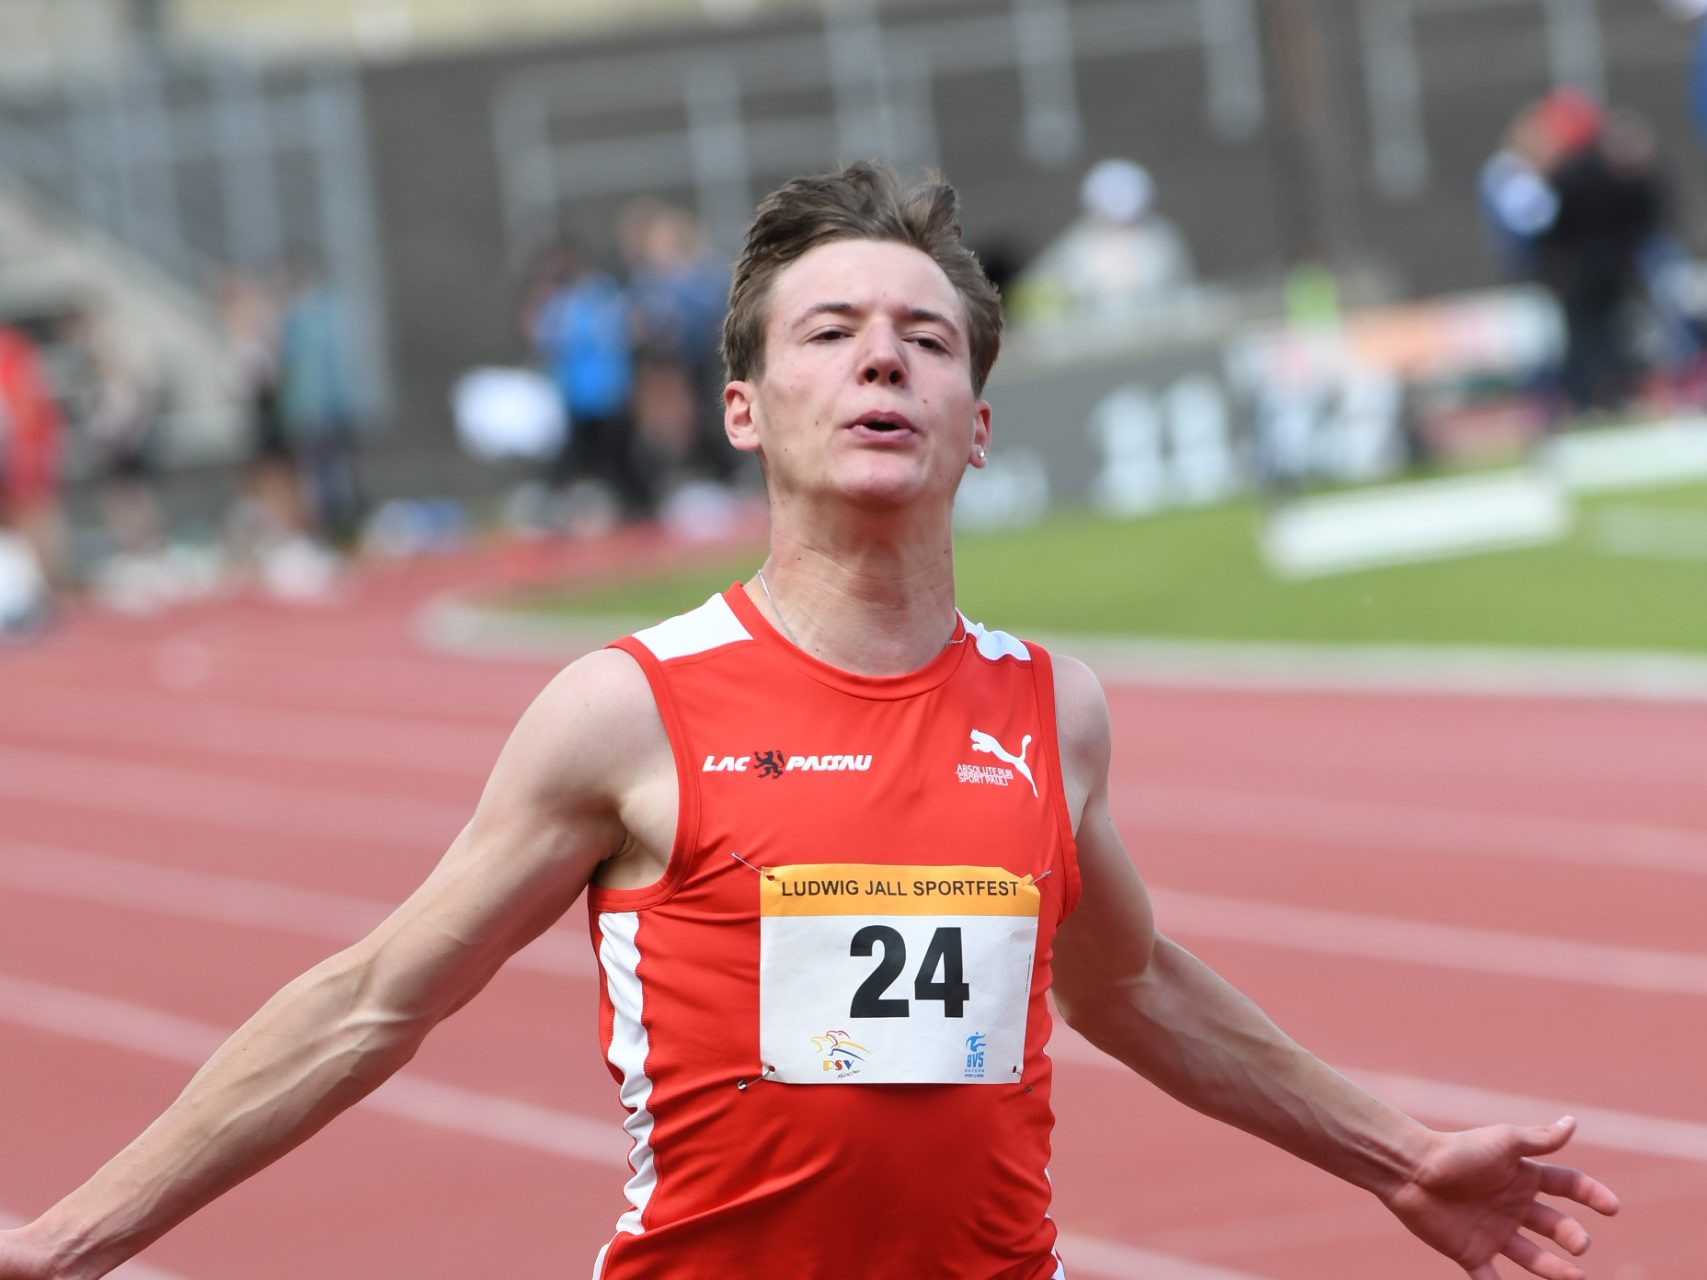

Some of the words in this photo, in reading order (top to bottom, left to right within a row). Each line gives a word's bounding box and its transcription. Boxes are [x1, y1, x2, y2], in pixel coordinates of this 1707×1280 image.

[702, 755, 750, 772] LAC
[786, 754, 872, 772] PASSAU
[958, 774, 984, 784] SPORT
[781, 879, 859, 897] LUDWIG
[865, 880, 908, 897] JALL
[913, 880, 1019, 897] SPORTFEST
[850, 924, 970, 1019] 24
[966, 1051, 985, 1068] BVS
